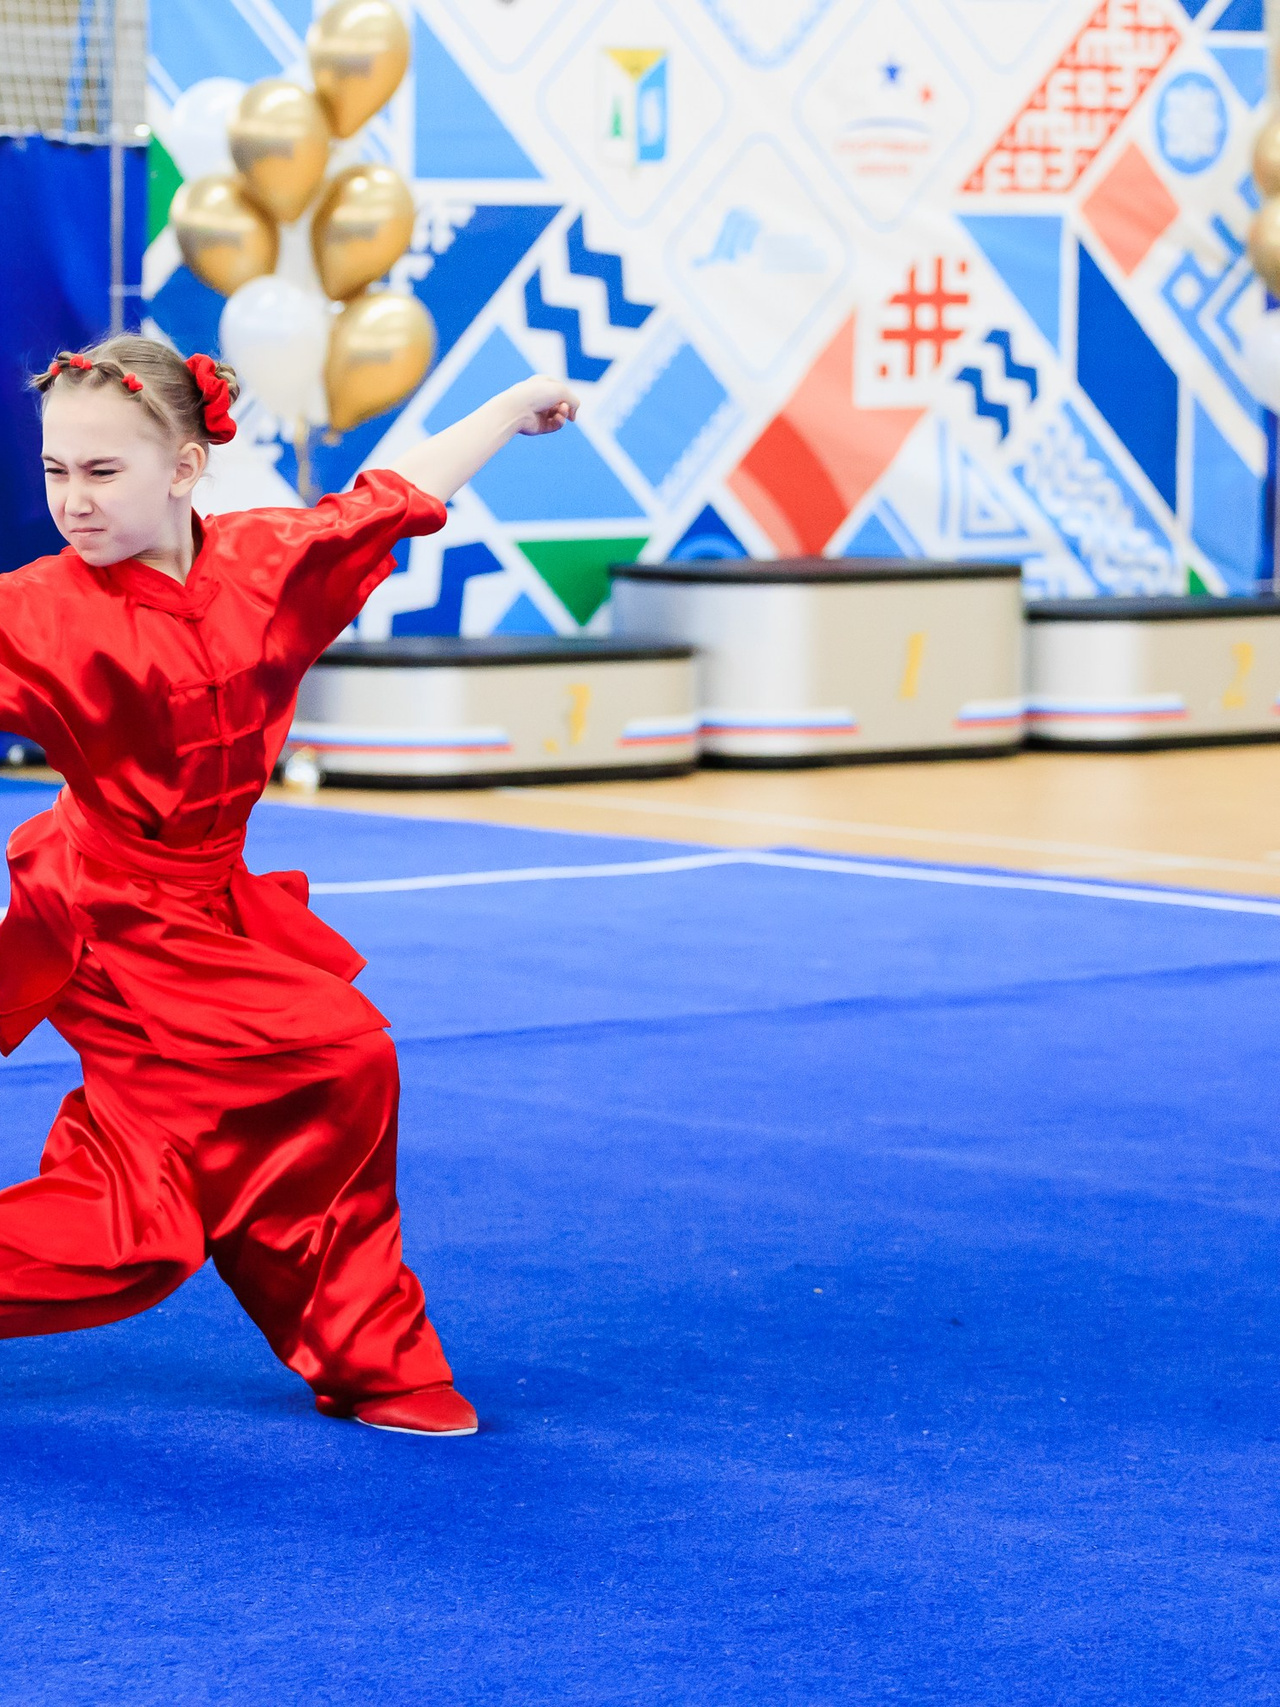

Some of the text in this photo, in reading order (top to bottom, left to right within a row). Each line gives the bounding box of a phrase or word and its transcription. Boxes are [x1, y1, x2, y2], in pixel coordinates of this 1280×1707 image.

[896, 630, 927, 702] 1
[1221, 642, 1255, 711] 2
[542, 683, 591, 755] 3
